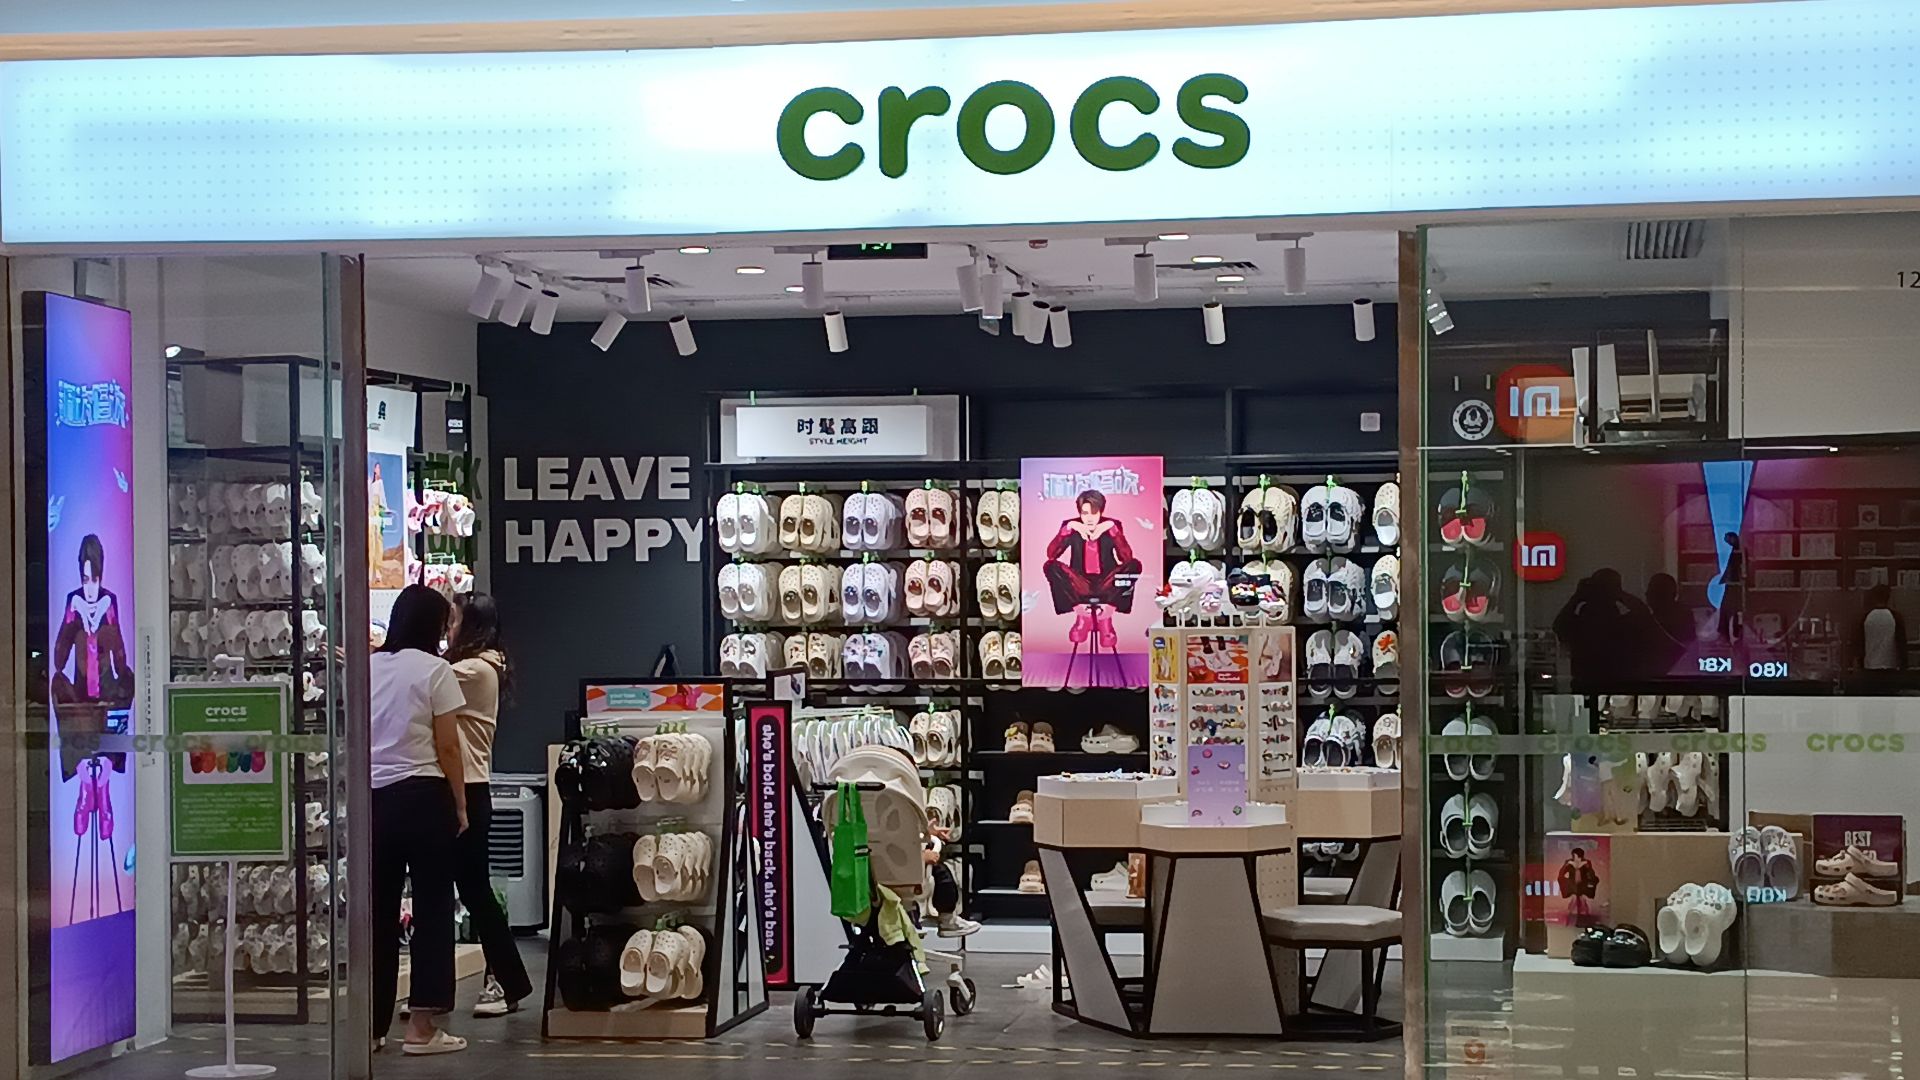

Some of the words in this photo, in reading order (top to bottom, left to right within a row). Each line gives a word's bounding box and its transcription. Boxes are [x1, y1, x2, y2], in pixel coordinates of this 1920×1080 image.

[777, 73, 1251, 181] crocs
[836, 437, 868, 445] HEIGHT
[504, 456, 690, 500] LEAVE
[505, 518, 703, 563] HAPPY
[205, 706, 247, 716] crocs
[133, 735, 212, 752] crocs
[245, 735, 325, 752] crocs
[1538, 735, 1631, 752] crocs
[1672, 734, 1767, 752] crocs
[1807, 733, 1905, 752] crocs
[763, 764, 775, 800] bold.
[1844, 831, 1872, 847] BEST
[764, 841, 777, 879] back.
